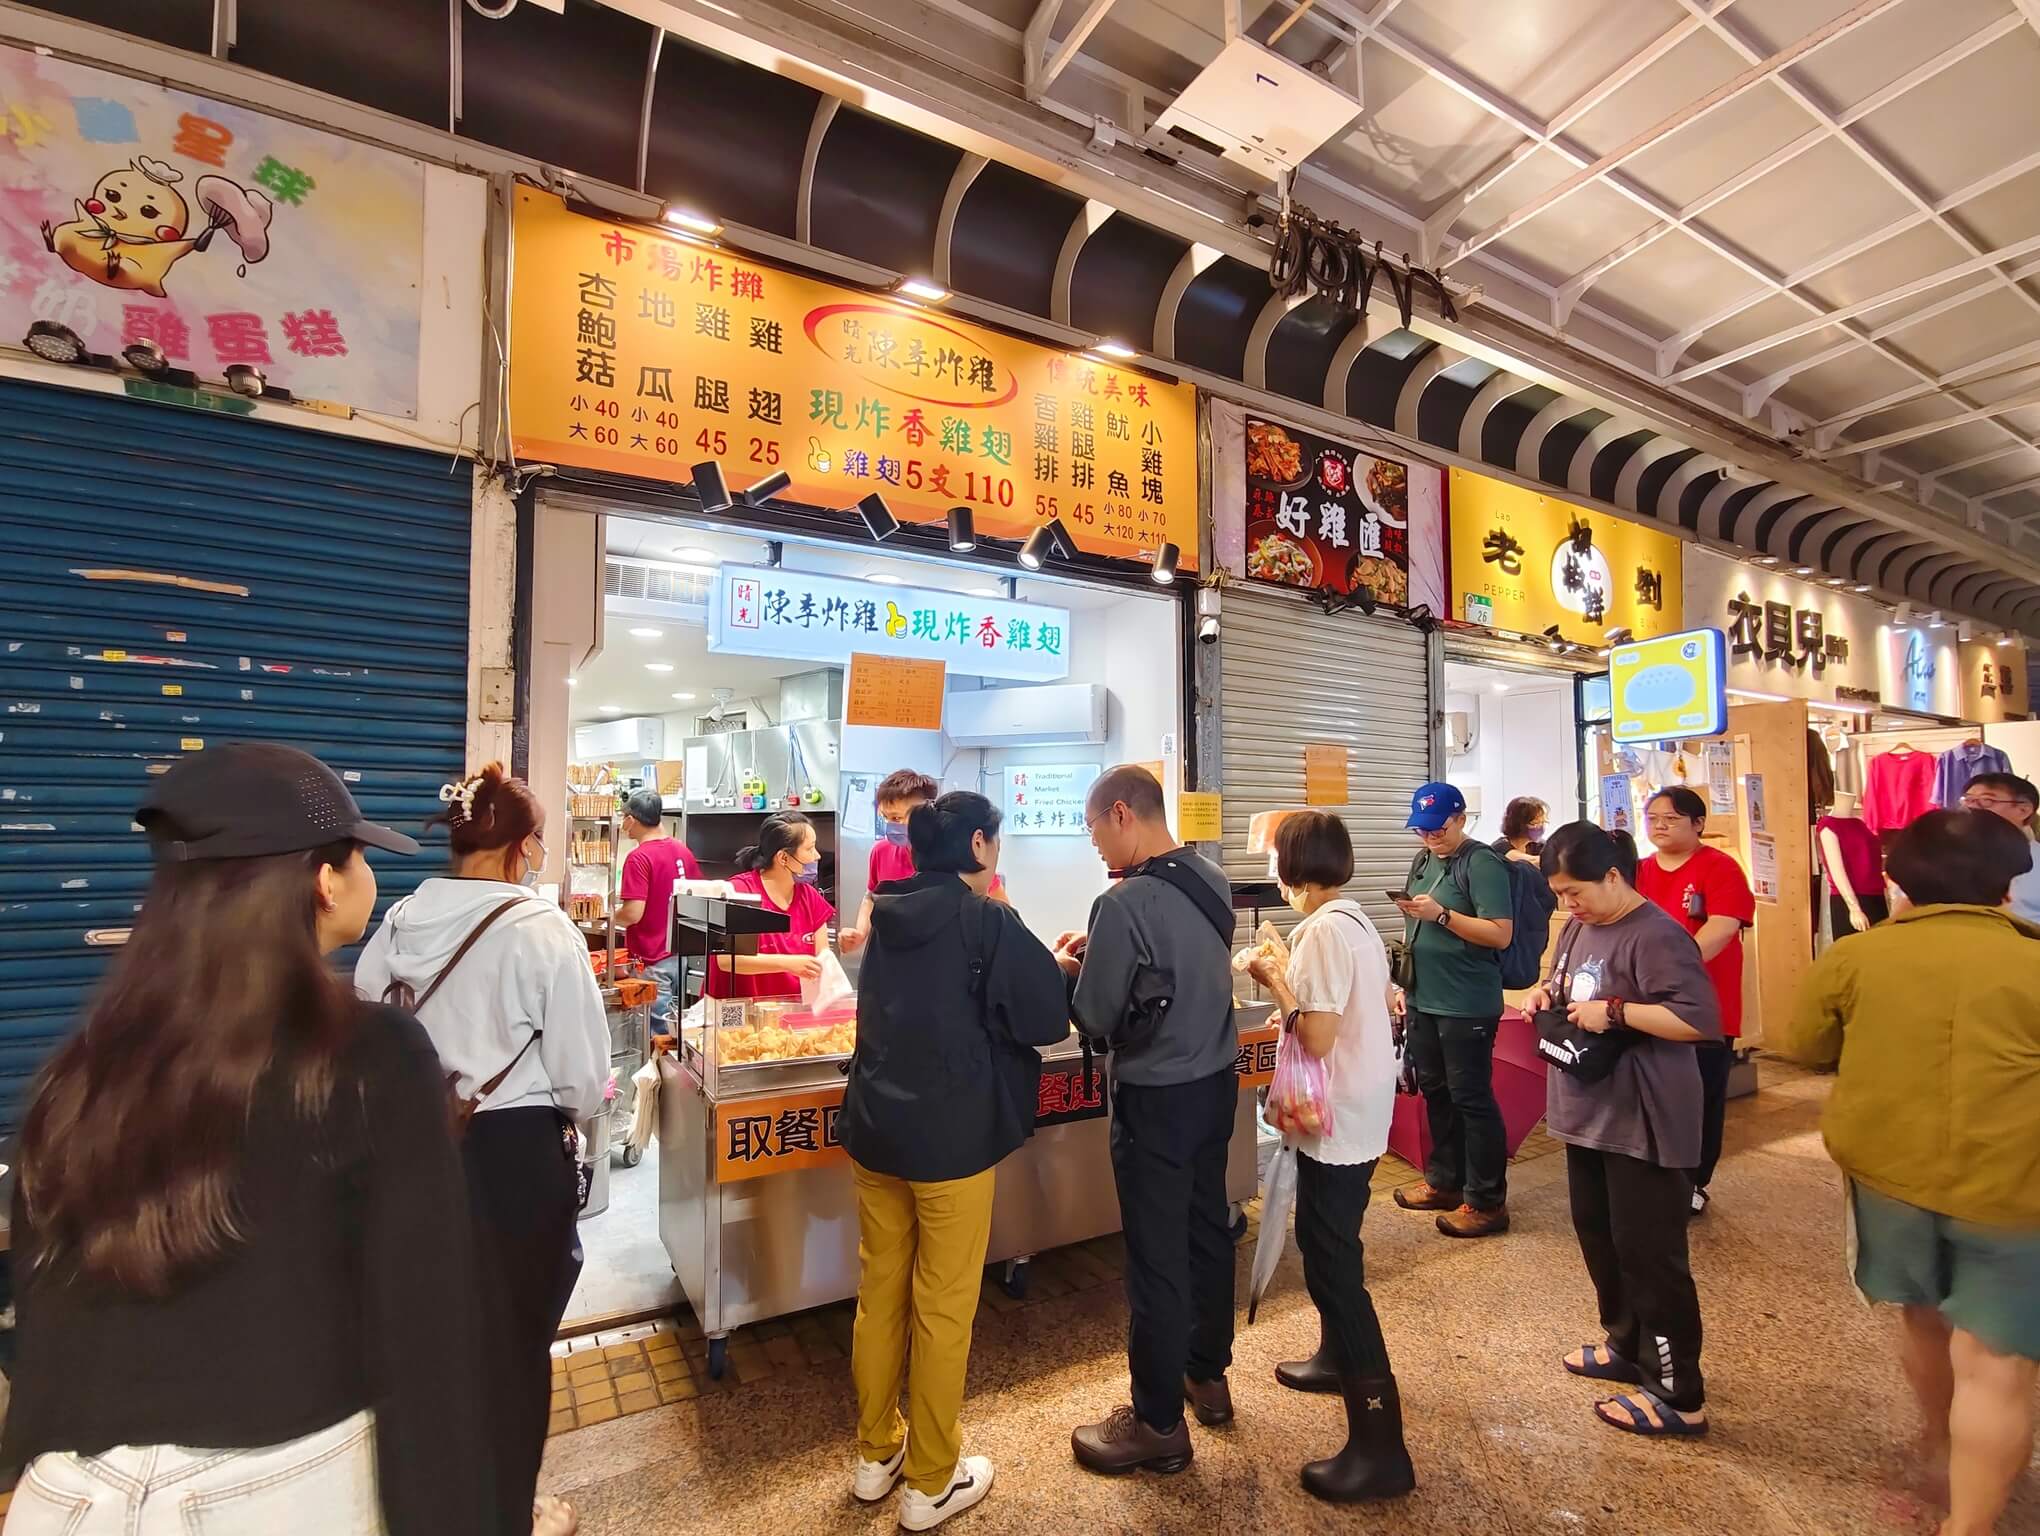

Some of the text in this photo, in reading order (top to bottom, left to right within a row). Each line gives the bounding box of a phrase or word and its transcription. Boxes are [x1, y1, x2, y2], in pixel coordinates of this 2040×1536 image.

[600, 229, 765, 303] 市場炸攤
[576, 272, 617, 388] 杏鮑菇
[636, 287, 675, 404] 地瓜
[694, 302, 730, 414] 雞腿
[748, 316, 783, 426] 雞翅
[695, 427, 728, 456] 45
[749, 437, 780, 466] 25
[808, 388, 1013, 466] 現炸香雞翅
[1034, 392, 1059, 484] 香雞排
[1071, 400, 1095, 490] 雞腿排
[1106, 410, 1130, 499] 魷魚
[1141, 419, 1164, 505] 小雞塊
[1035, 494, 1058, 519] 55
[1072, 502, 1094, 526] 45
[737, 584, 753, 624] 晴光
[1477, 611, 1488, 623] 26
[1483, 583, 1526, 602] PEPPER
[911, 609, 1062, 655] 現炸香雞翅
[1035, 772, 1073, 780] Traditional
[1539, 1038, 1574, 1065] PUMA
